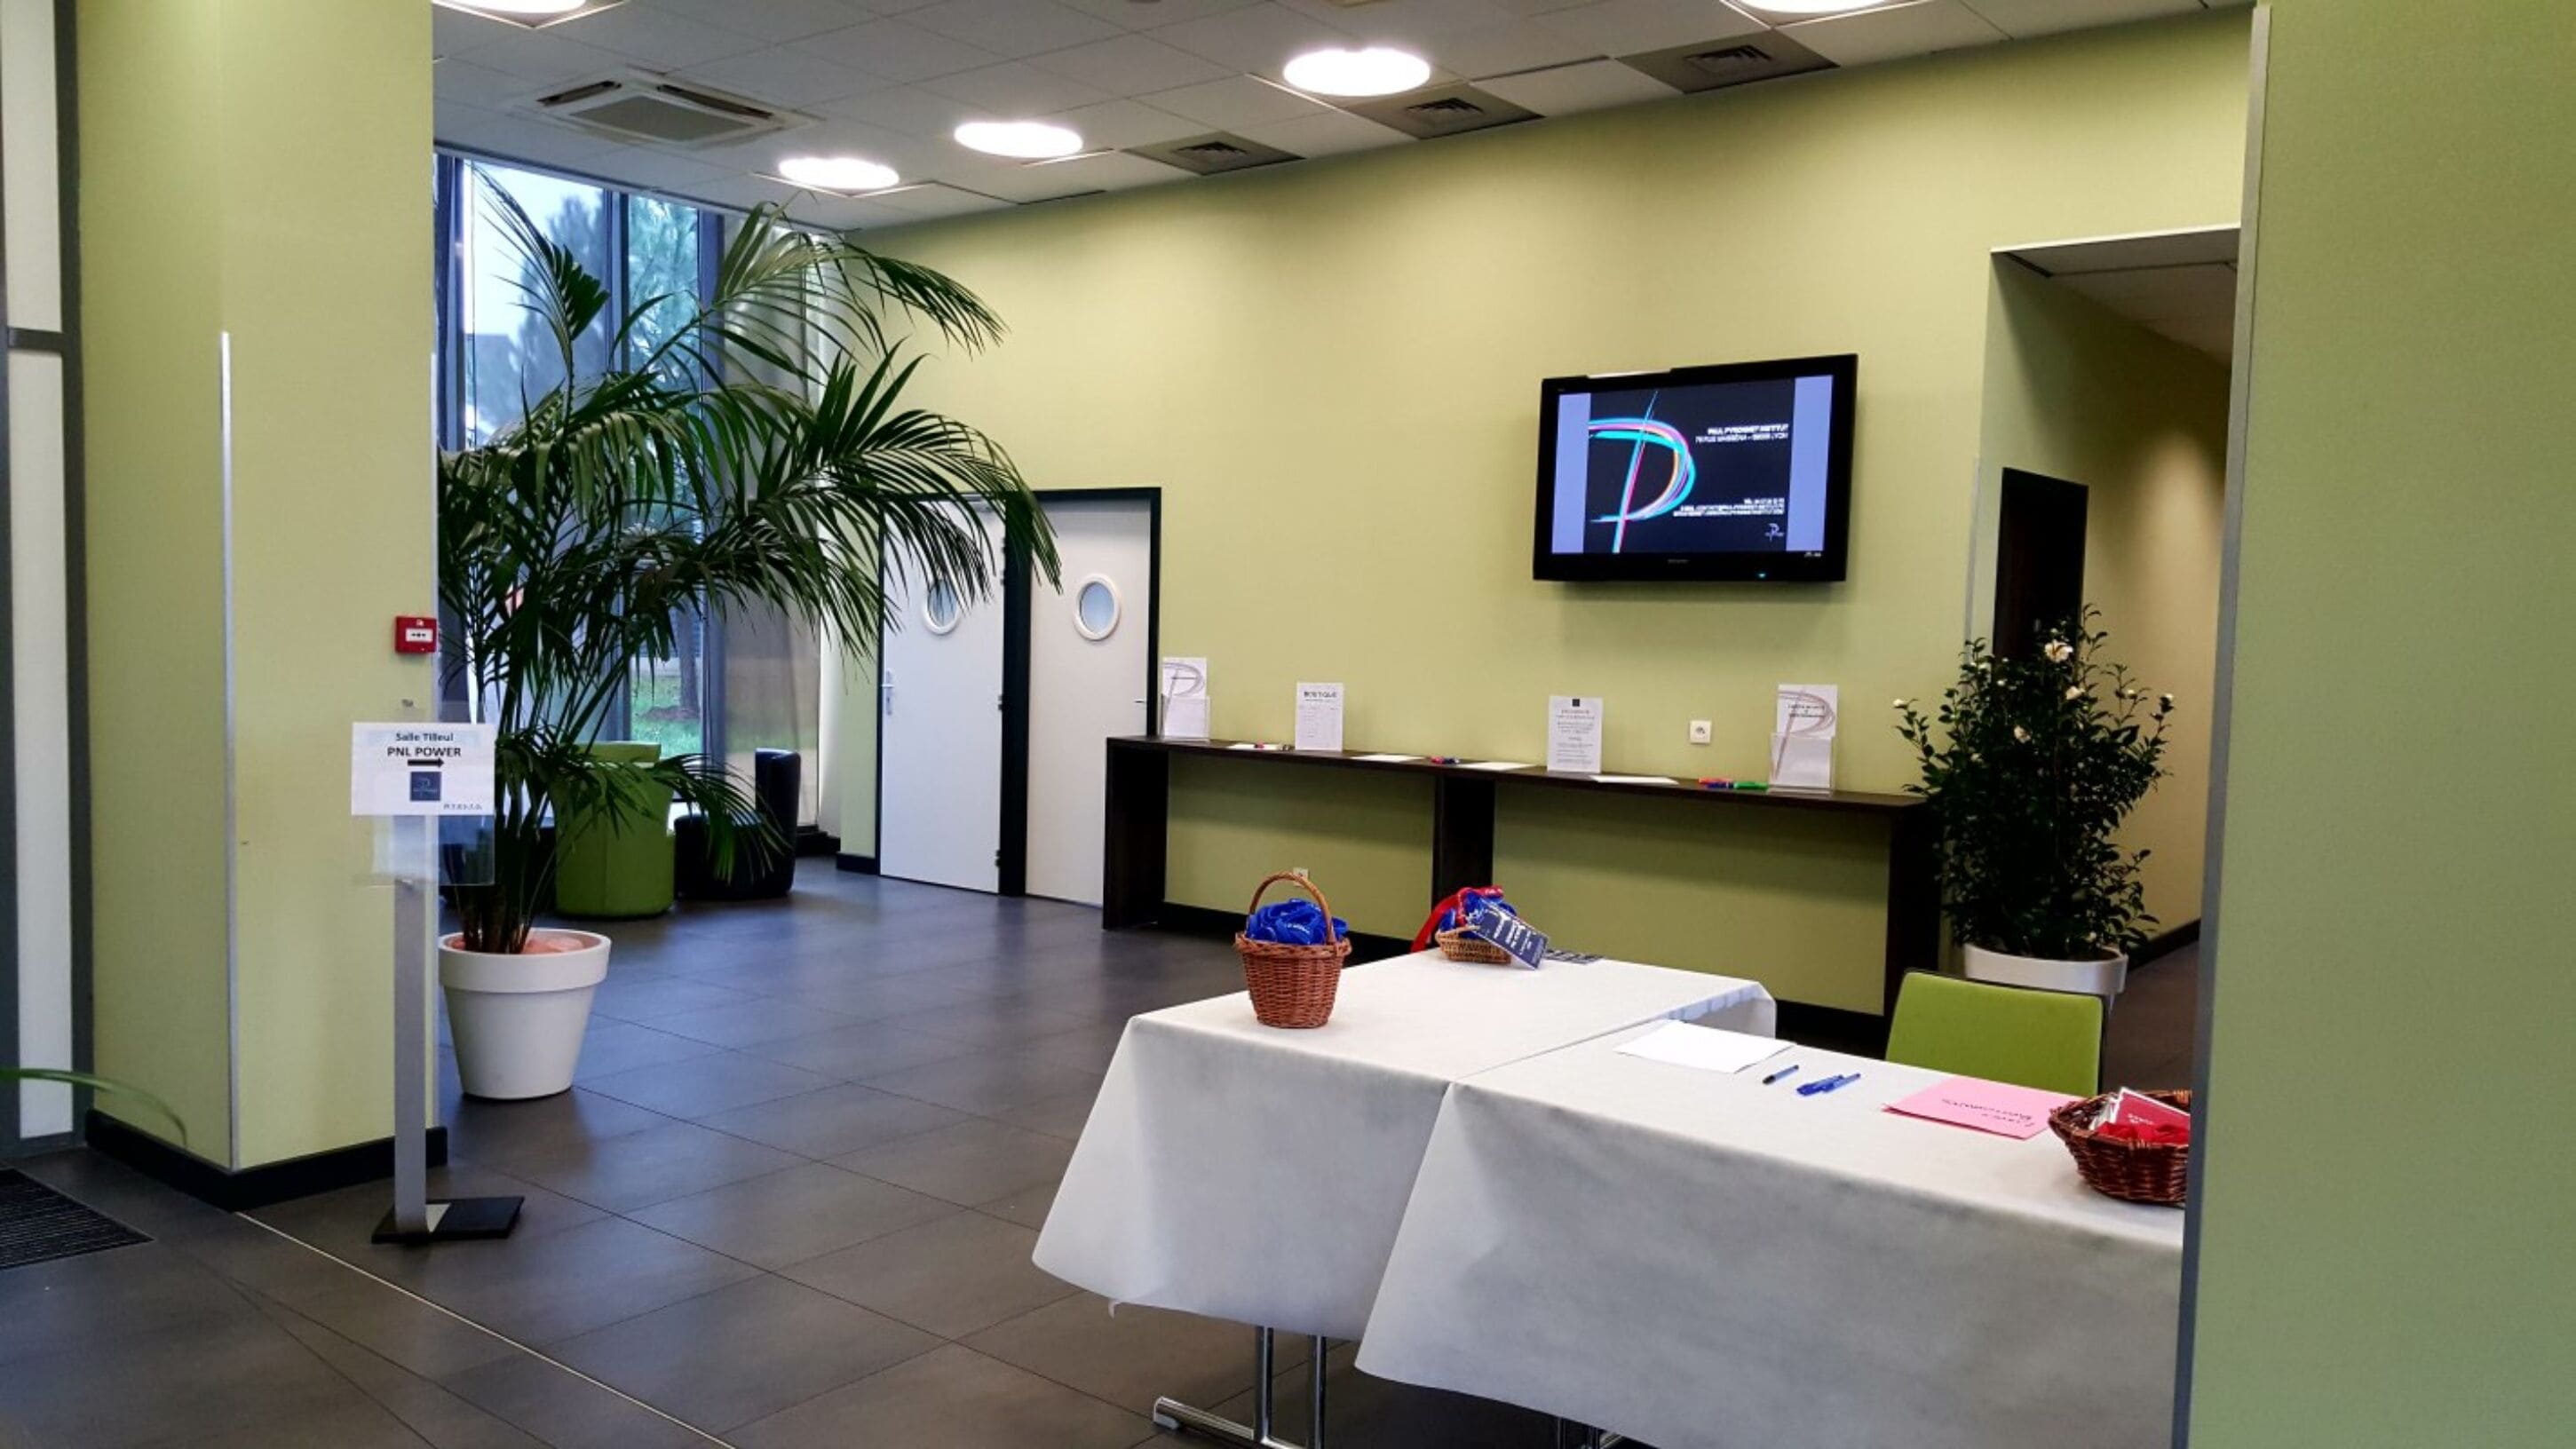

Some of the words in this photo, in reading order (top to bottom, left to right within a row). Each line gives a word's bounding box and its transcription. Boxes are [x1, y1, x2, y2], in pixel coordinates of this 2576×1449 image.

[395, 732, 421, 742] Salle
[422, 732, 455, 742] Tilleul
[386, 747, 411, 757] PNL
[415, 747, 462, 757] POWER
